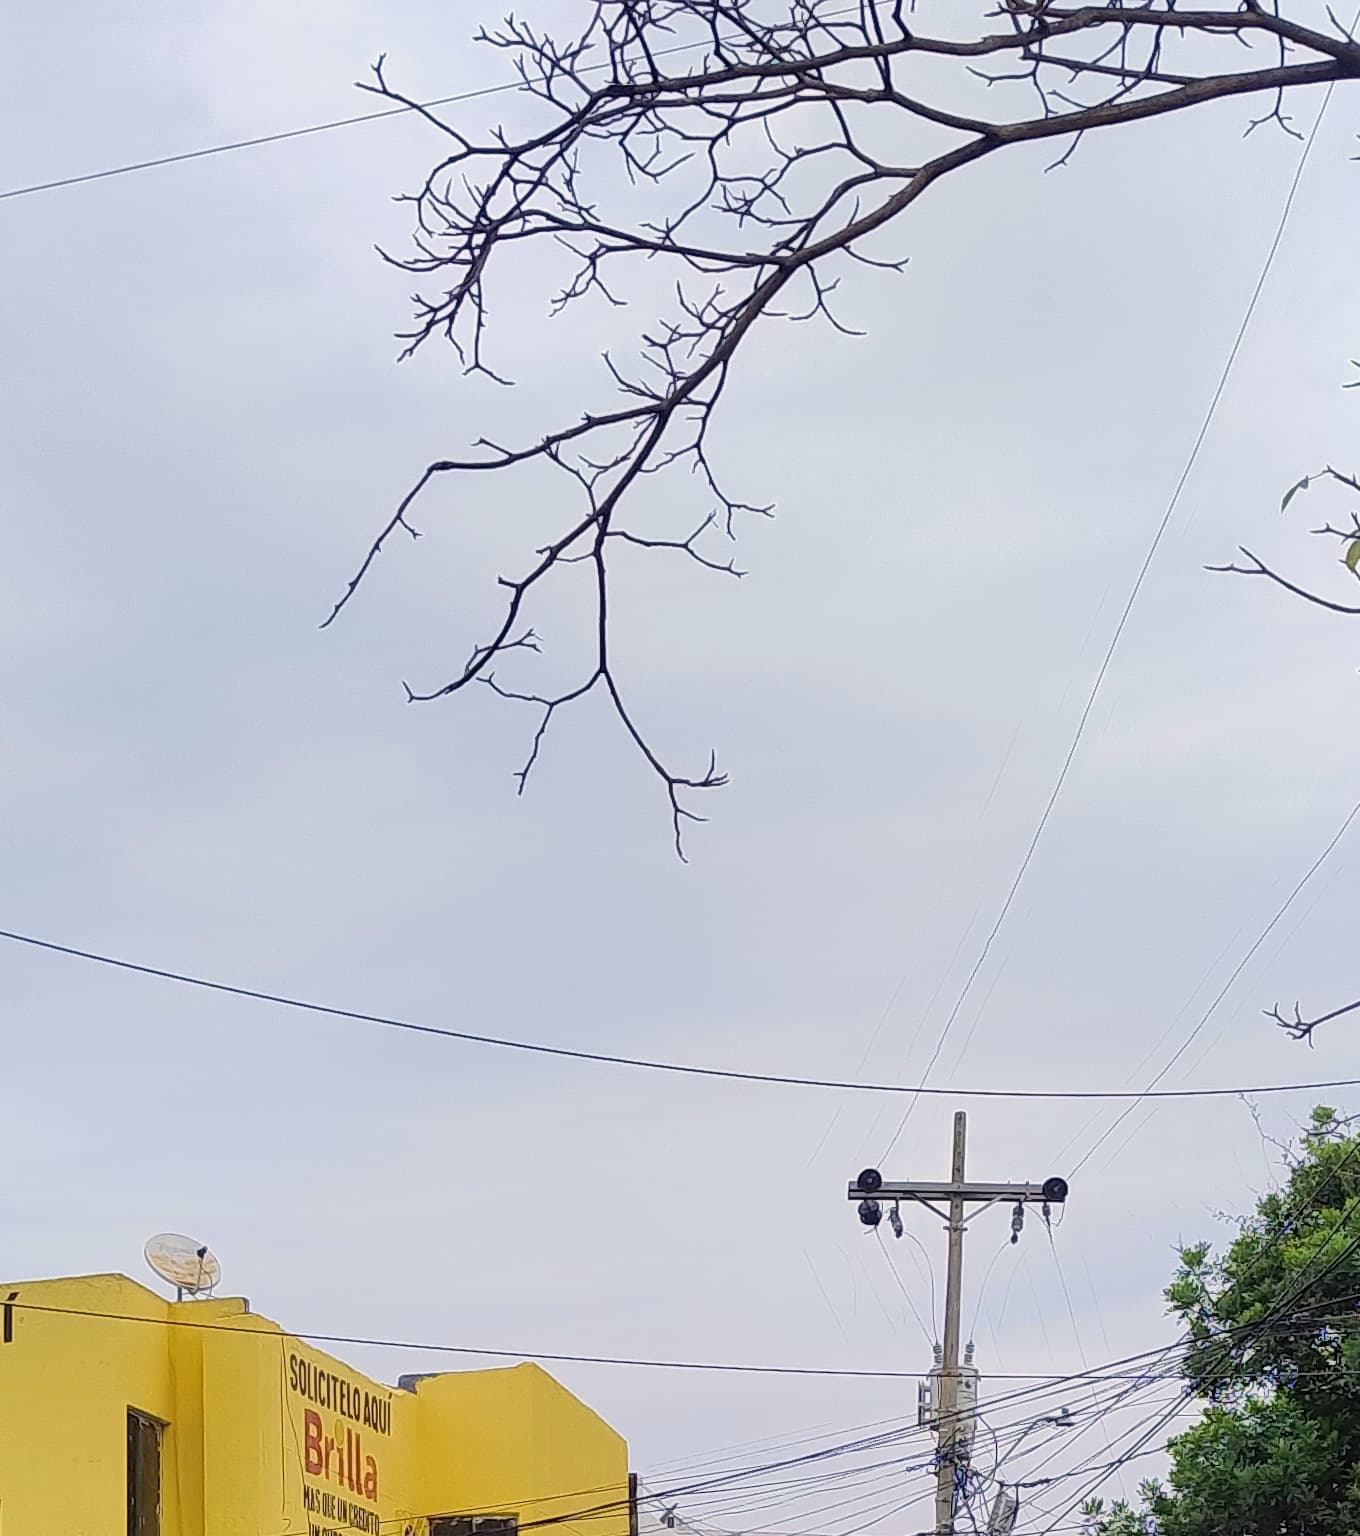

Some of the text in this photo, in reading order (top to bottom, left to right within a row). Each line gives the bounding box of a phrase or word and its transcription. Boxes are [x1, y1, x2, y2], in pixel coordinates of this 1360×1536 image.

[290, 1353, 392, 1435] SOLICITELO AQUÍ
[304, 1408, 378, 1503] Brilla
[303, 1484, 380, 1536] MAS QUE UN CREDITO
